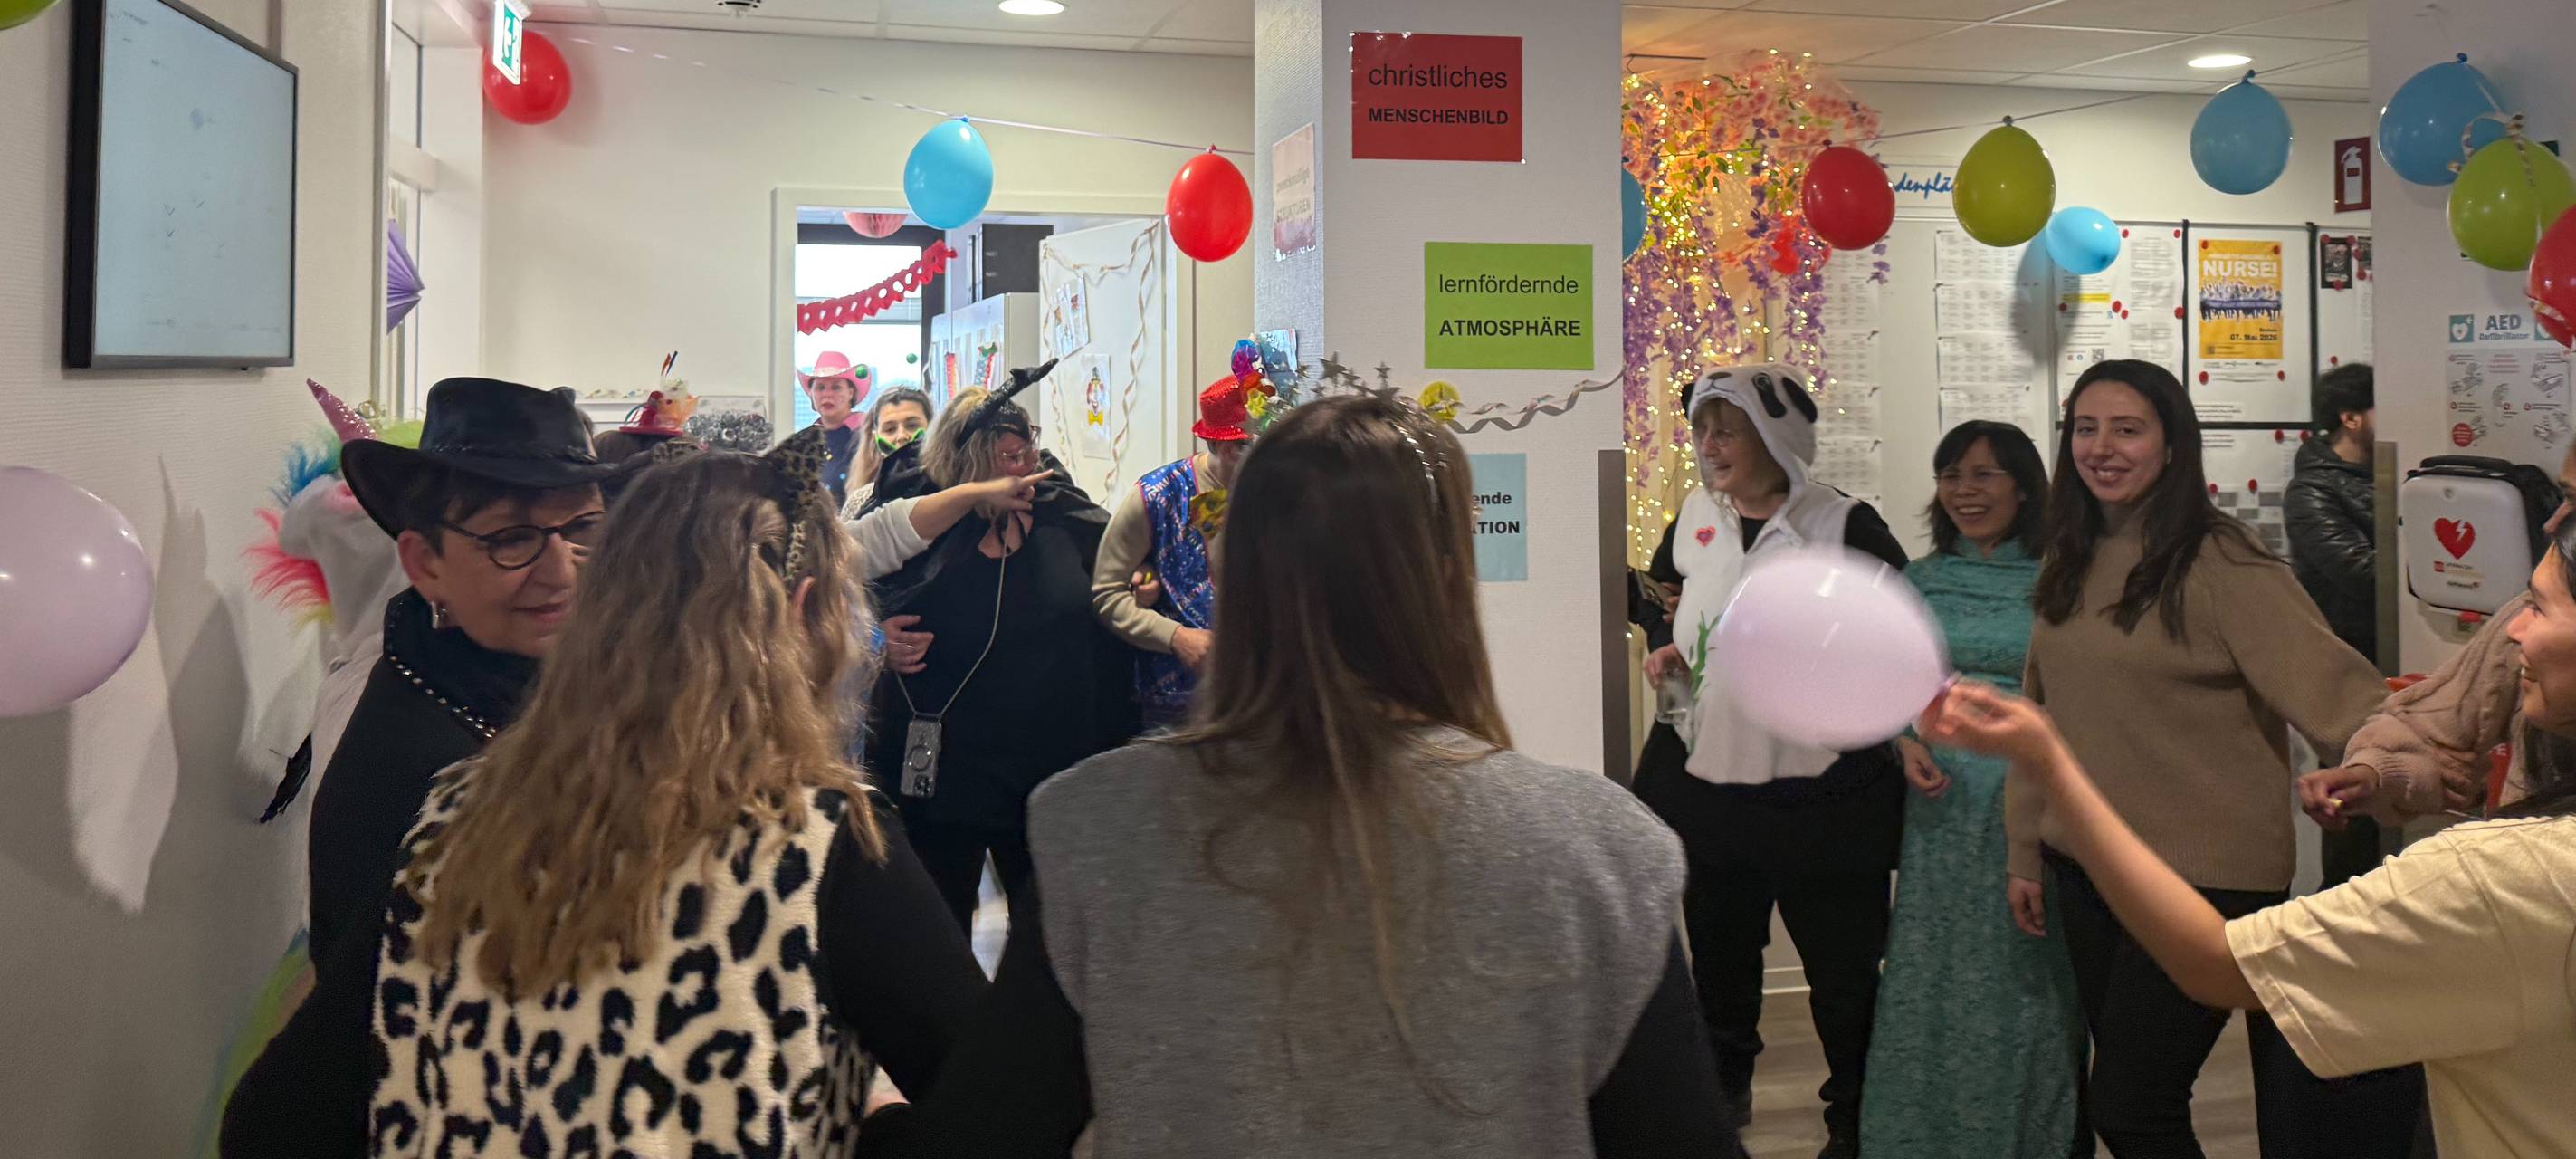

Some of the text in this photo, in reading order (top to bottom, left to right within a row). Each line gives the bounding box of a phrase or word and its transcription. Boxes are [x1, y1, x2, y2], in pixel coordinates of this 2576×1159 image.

[1368, 63, 1508, 89] christliches
[1369, 108, 1509, 125] MENSCHENBILD
[1894, 172, 1954, 200] denplä
[2203, 259, 2277, 278] NURSE!
[1439, 273, 1579, 294] lernfördernde
[1439, 317, 1581, 336] ATMOSPHÄRE
[2485, 314, 2522, 330] AED
[1473, 521, 1520, 534] TION
